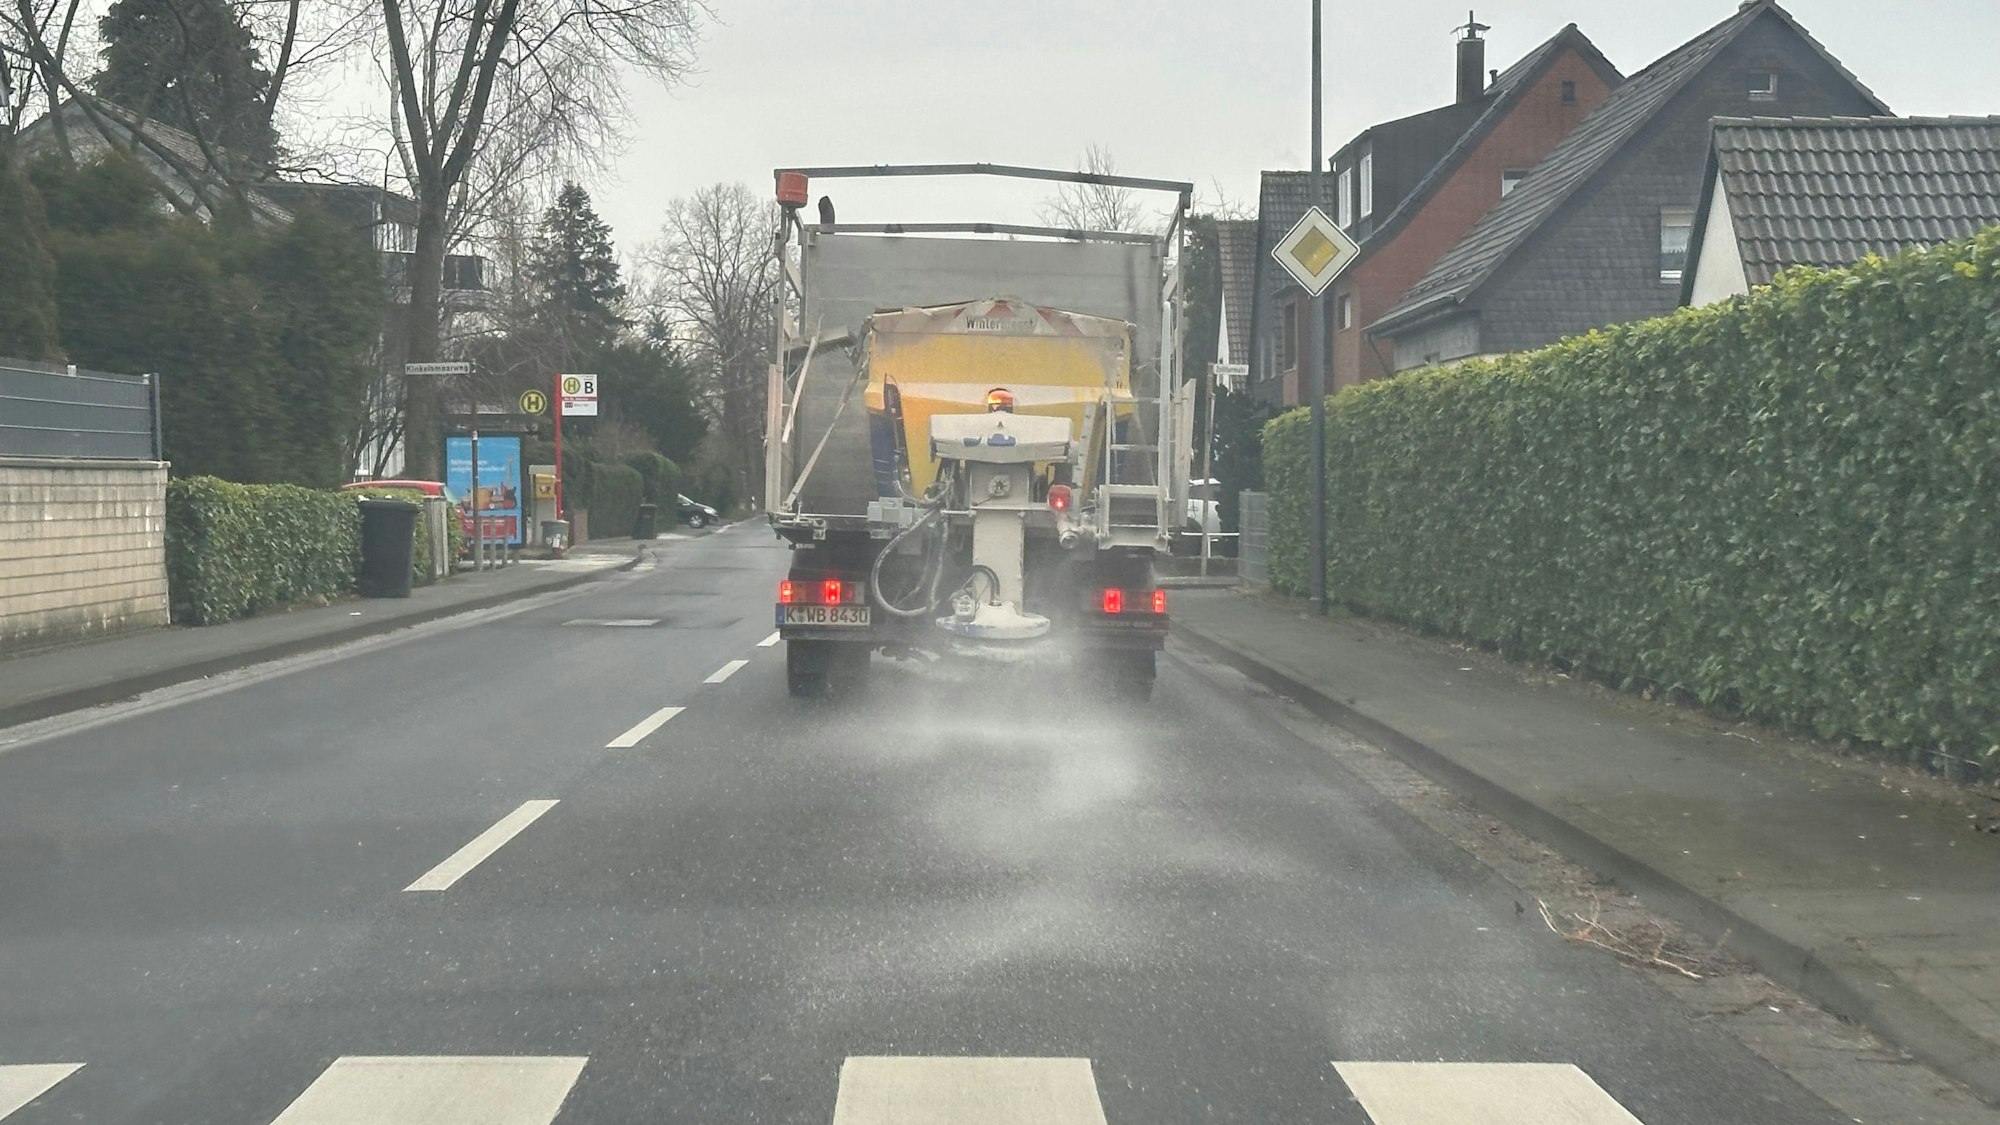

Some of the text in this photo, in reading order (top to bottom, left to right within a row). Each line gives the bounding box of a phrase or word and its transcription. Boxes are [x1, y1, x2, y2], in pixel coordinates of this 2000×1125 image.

[966, 316, 1034, 330] Winterenst
[567, 380, 577, 392] H
[584, 381, 594, 394] B
[527, 396, 540, 410] H
[785, 606, 869, 623] K WB 8430
